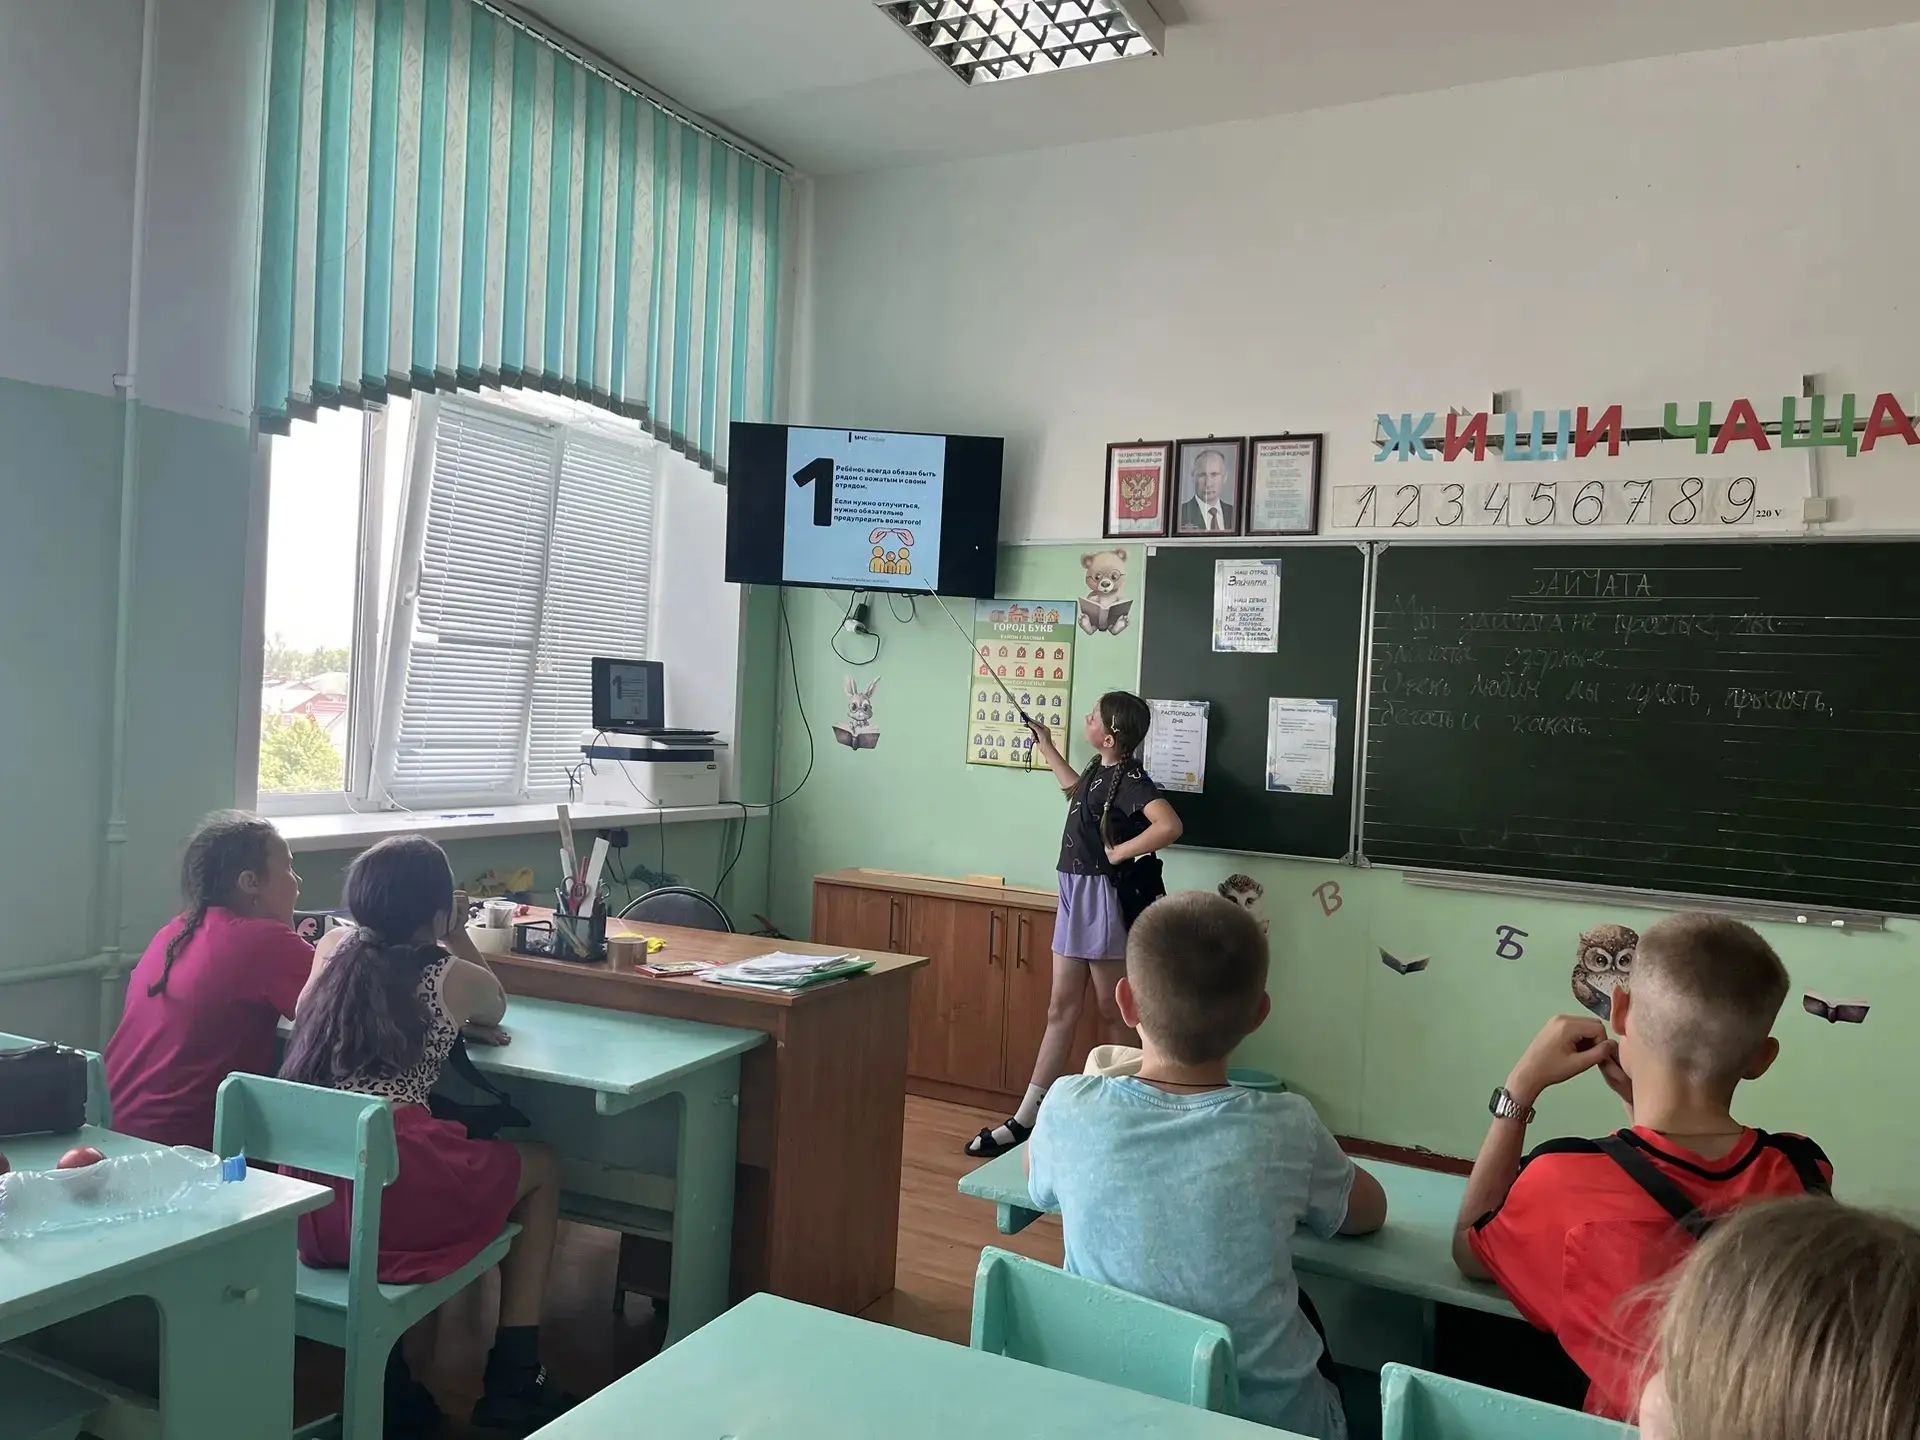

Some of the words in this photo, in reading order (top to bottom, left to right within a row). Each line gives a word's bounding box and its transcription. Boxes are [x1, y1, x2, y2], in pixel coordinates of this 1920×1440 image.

[892, 468, 917, 476] обязан
[918, 469, 936, 477] быть
[835, 474, 858, 482] рядом
[792, 457, 834, 526] 1
[853, 500, 876, 508] нужно
[1358, 485, 1376, 527] 1
[1391, 484, 1419, 527] 2
[1435, 483, 1464, 526] 3
[1484, 482, 1509, 525] 4
[1525, 482, 1557, 525] 5
[1573, 481, 1604, 525] 6
[1623, 480, 1653, 524] 7
[1668, 477, 1704, 524] 8
[1721, 477, 1755, 524] 9
[858, 508, 904, 516] обязательно
[1756, 510, 1772, 518] 220
[1774, 510, 1782, 518] V
[834, 515, 884, 524] предупредить
[993, 622, 1026, 633] ГОРОД
[1028, 623, 1053, 633] БУКВ
[1312, 881, 1343, 917] В
[1495, 925, 1529, 960] Б
